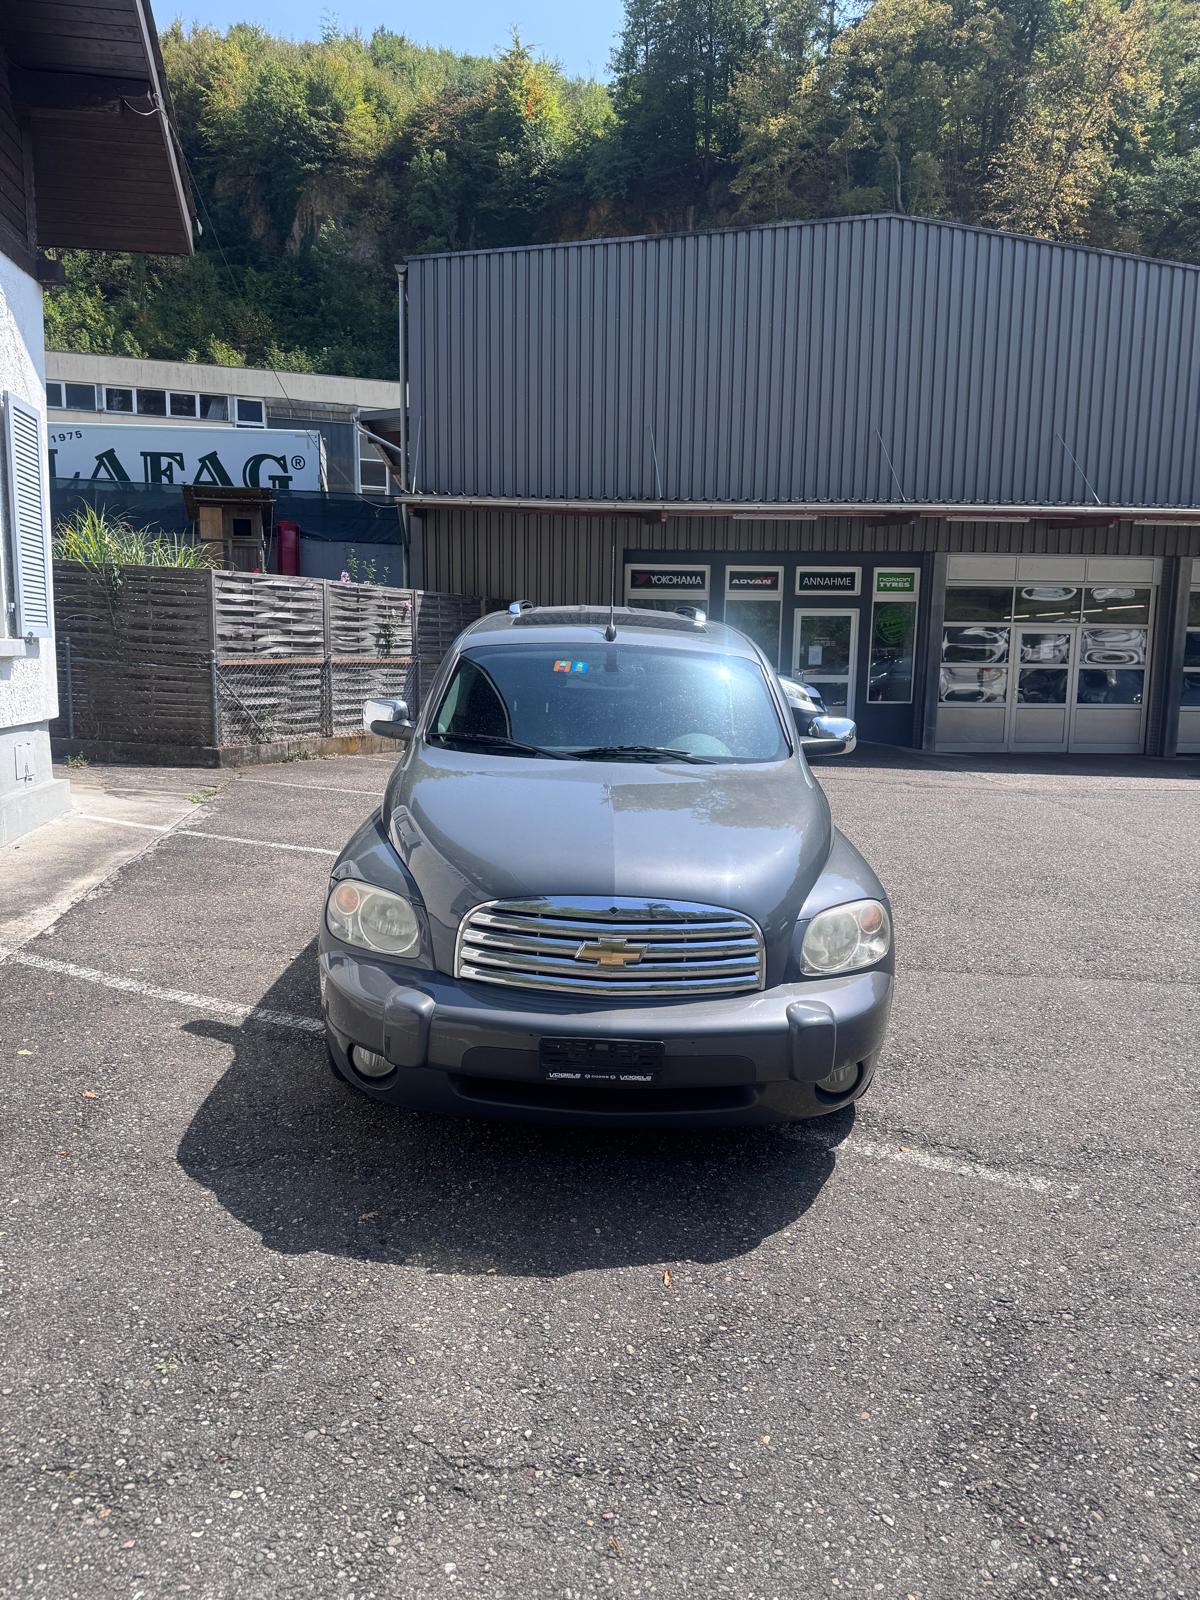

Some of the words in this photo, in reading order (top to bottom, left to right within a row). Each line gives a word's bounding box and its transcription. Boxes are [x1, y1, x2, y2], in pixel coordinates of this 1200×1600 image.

[51, 430, 83, 443] 1975
[650, 575, 702, 585] YOKOHAMA
[731, 577, 772, 585] ADVAN
[802, 577, 852, 586] ANNAHME
